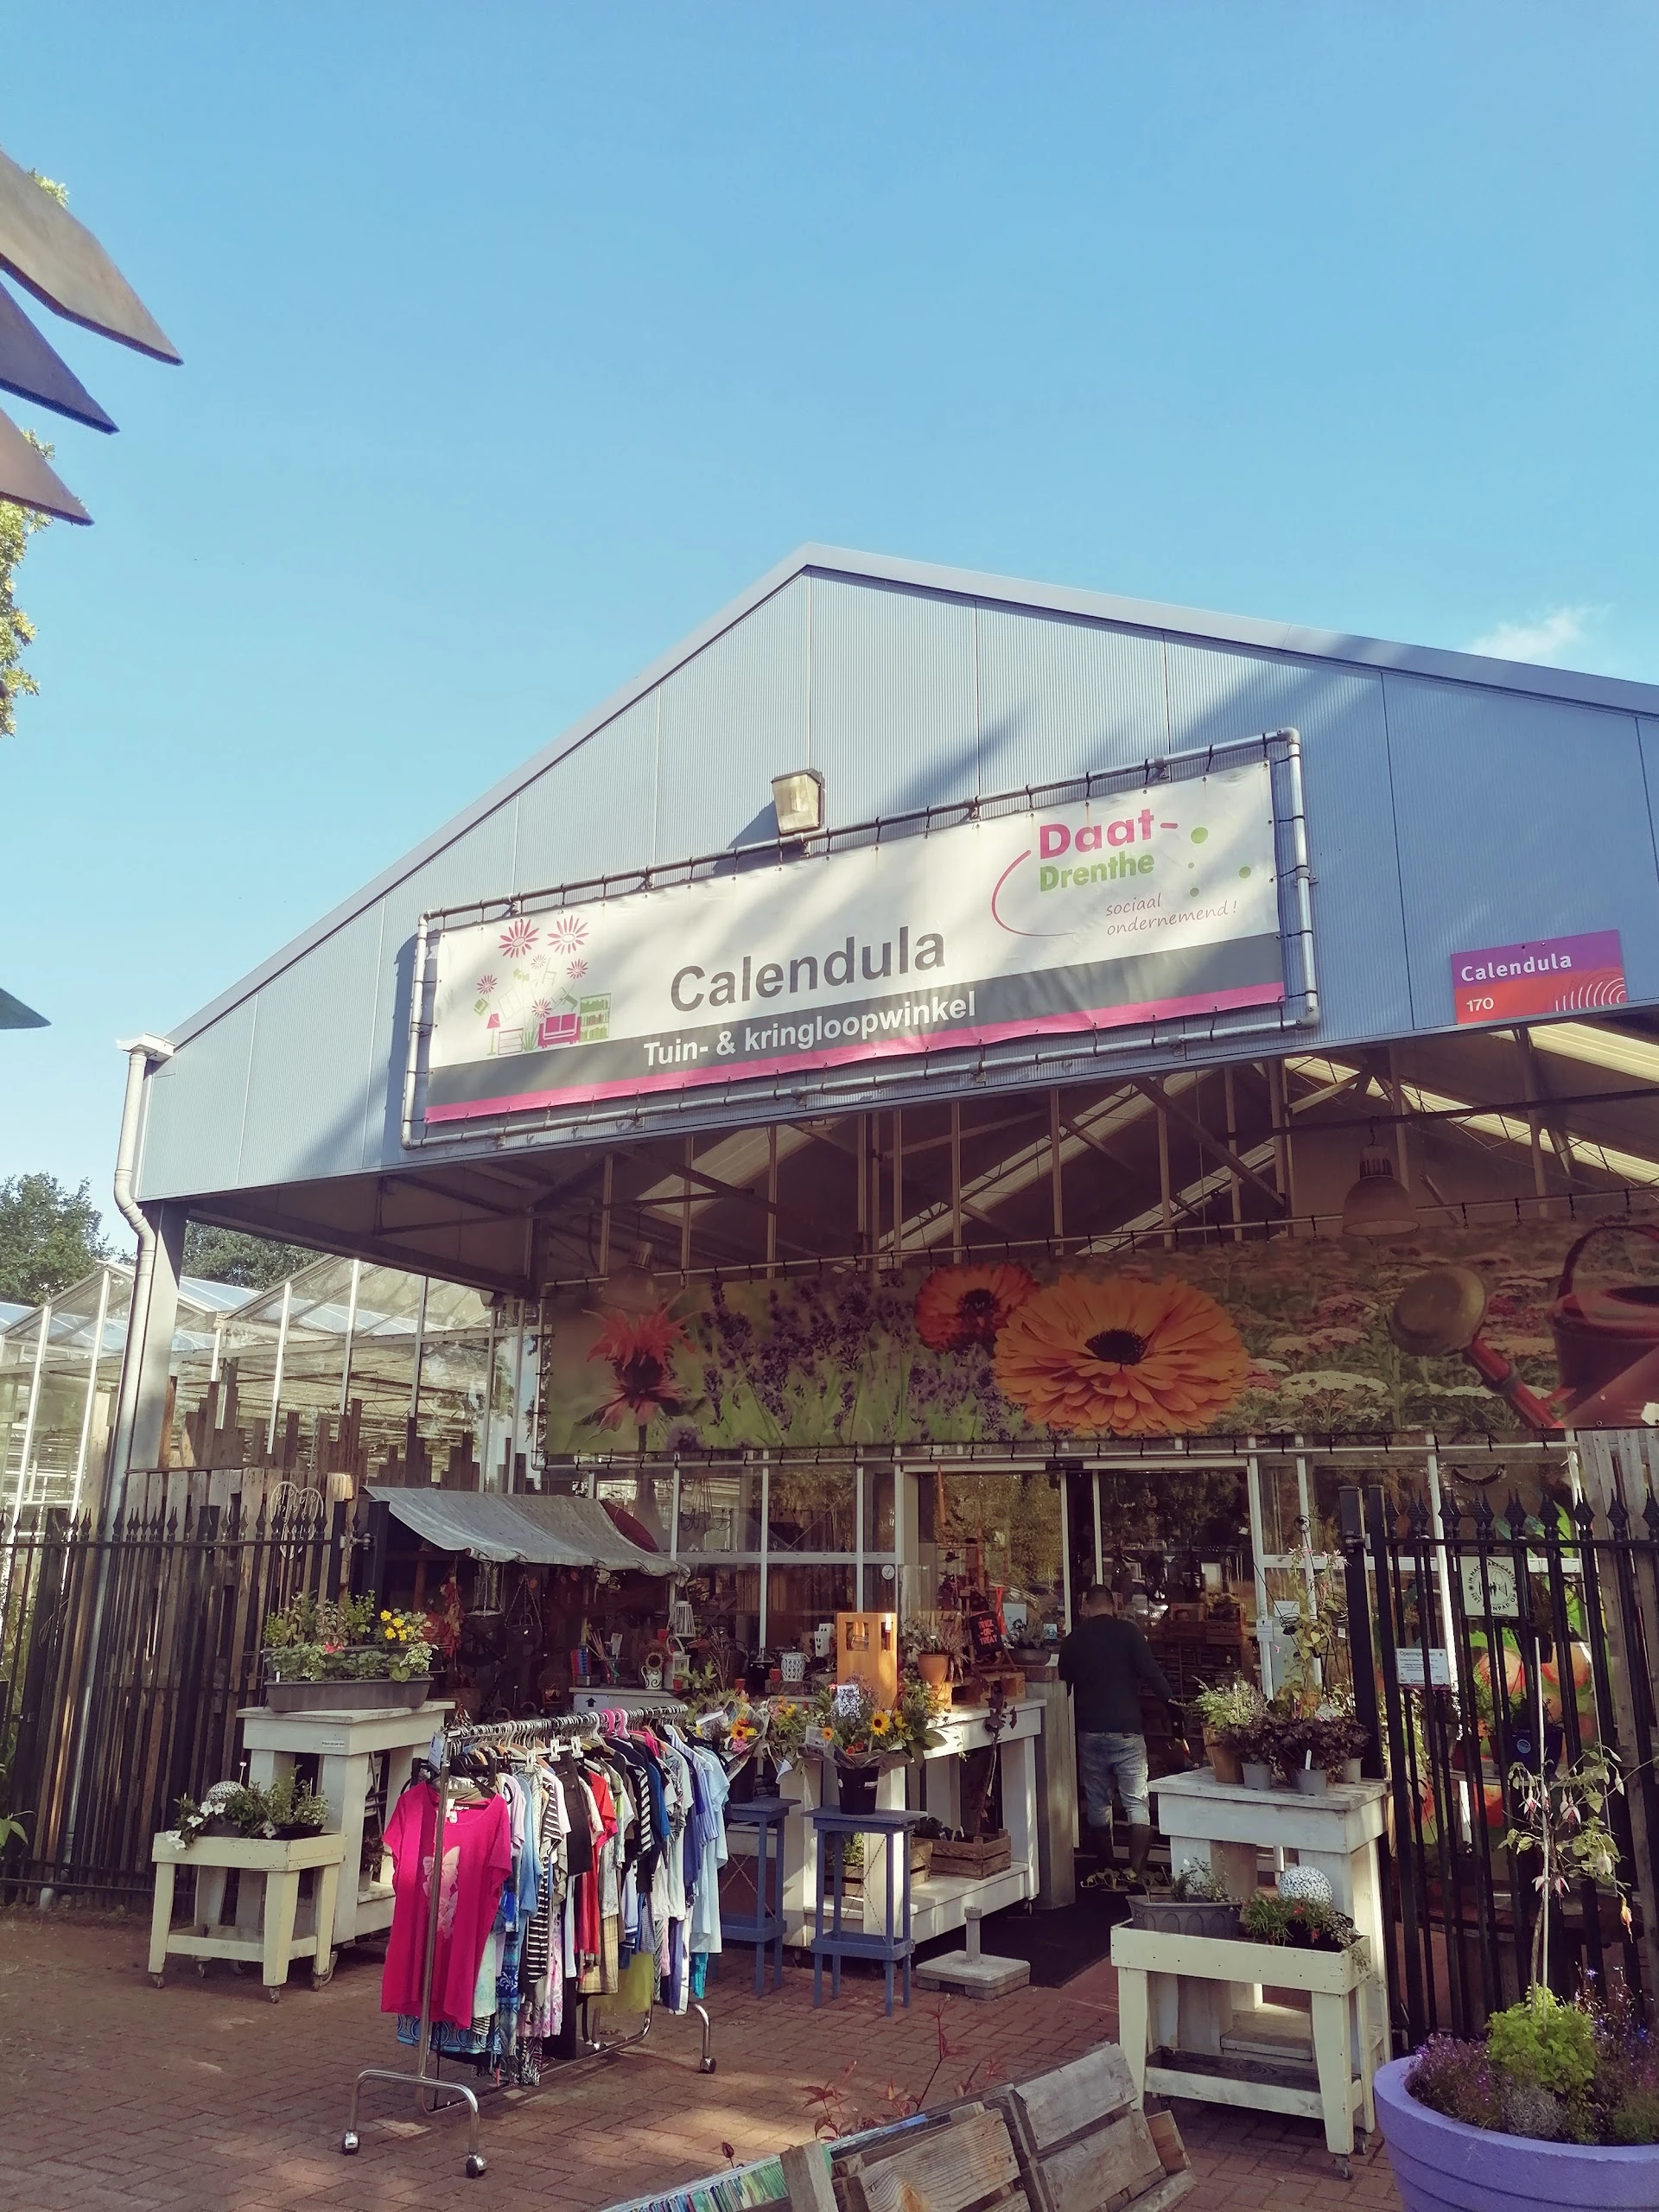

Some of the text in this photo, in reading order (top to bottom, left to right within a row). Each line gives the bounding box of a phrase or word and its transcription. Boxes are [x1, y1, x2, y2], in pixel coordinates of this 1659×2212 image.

[1039, 850, 1154, 892] Drenthe
[1106, 893, 1161, 917] sociaal
[671, 925, 946, 1012] Calendula
[1461, 953, 1573, 982] Calendula
[1466, 997, 1494, 1012] 170
[644, 991, 976, 1066] Tuin- & kringloopwinkel
[979, 1635, 997, 1645] TREAT
